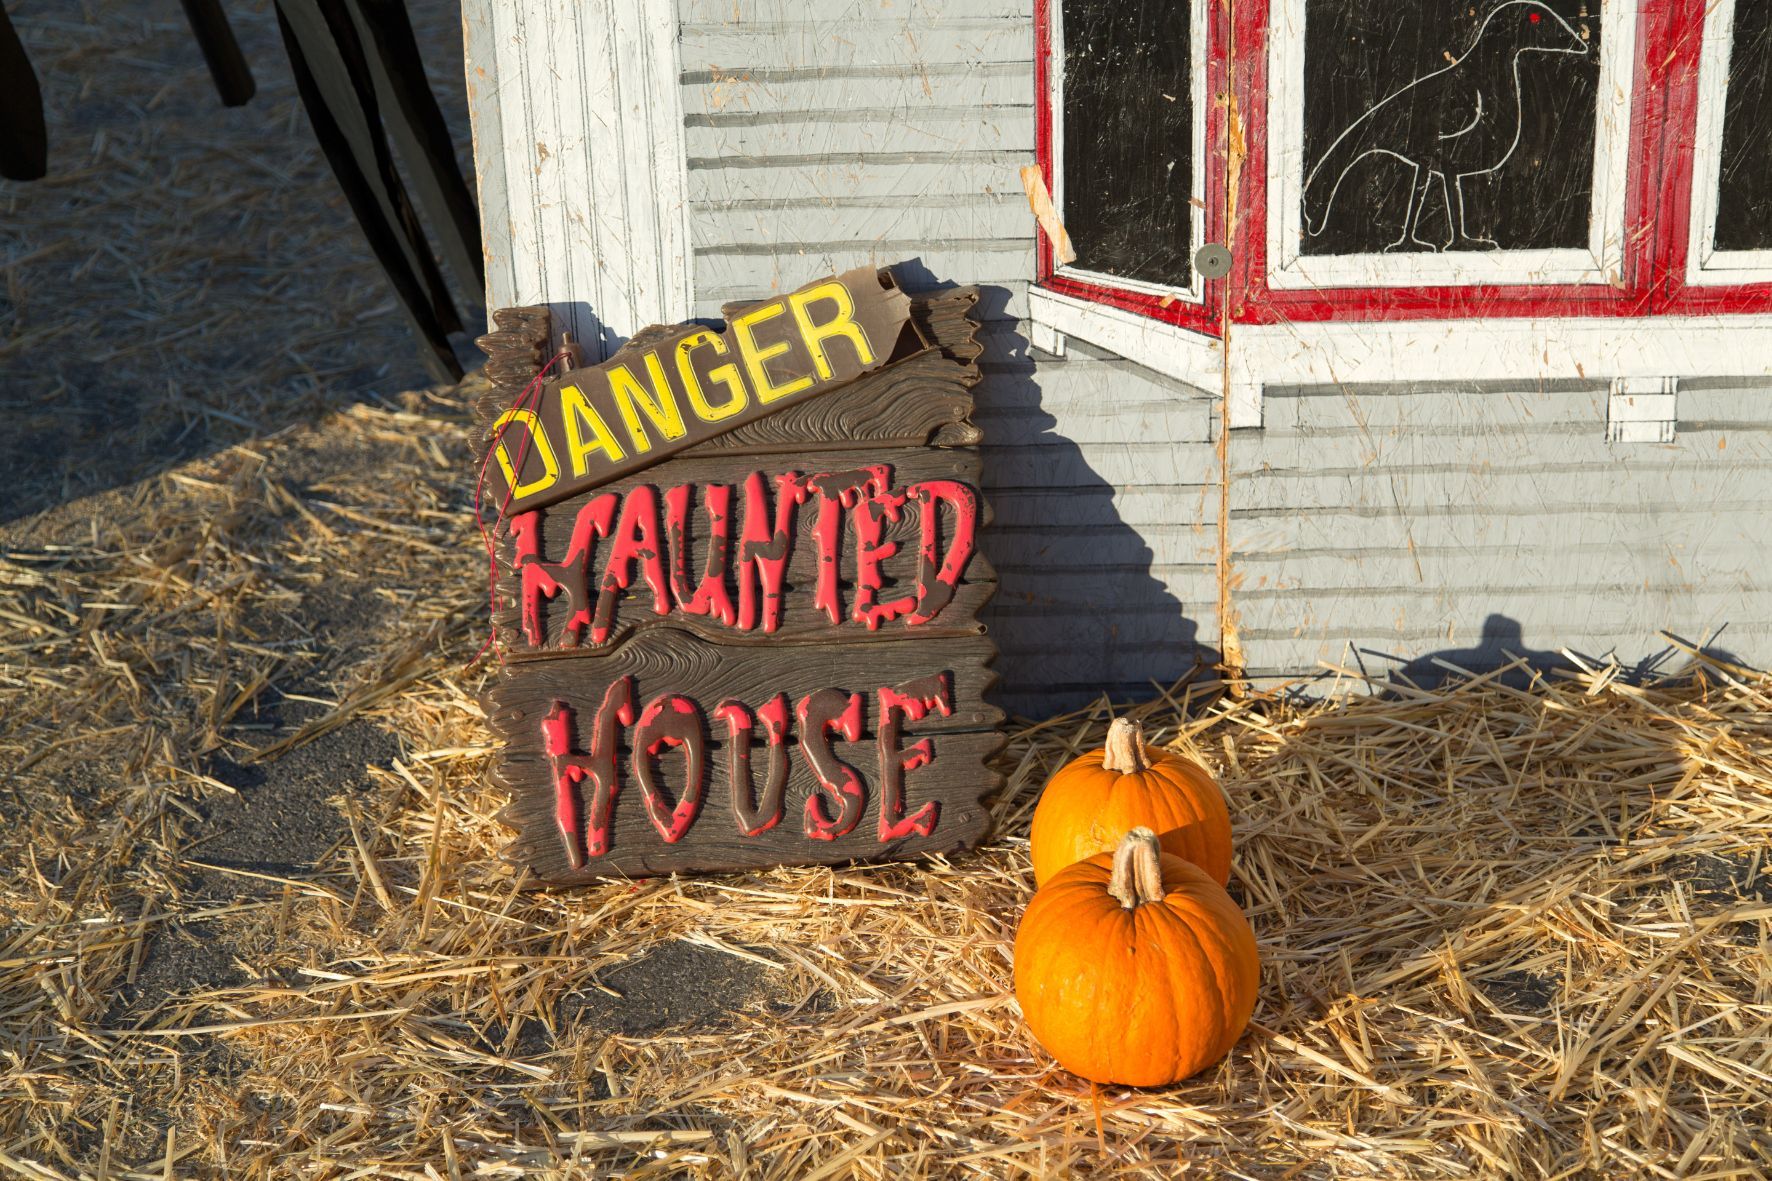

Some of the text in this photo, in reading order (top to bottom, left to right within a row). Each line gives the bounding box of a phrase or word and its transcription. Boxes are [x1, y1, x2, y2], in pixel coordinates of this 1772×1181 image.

[492, 281, 876, 500] DANGER
[509, 464, 977, 648] HAUNTED
[541, 670, 951, 870] HOUSE
